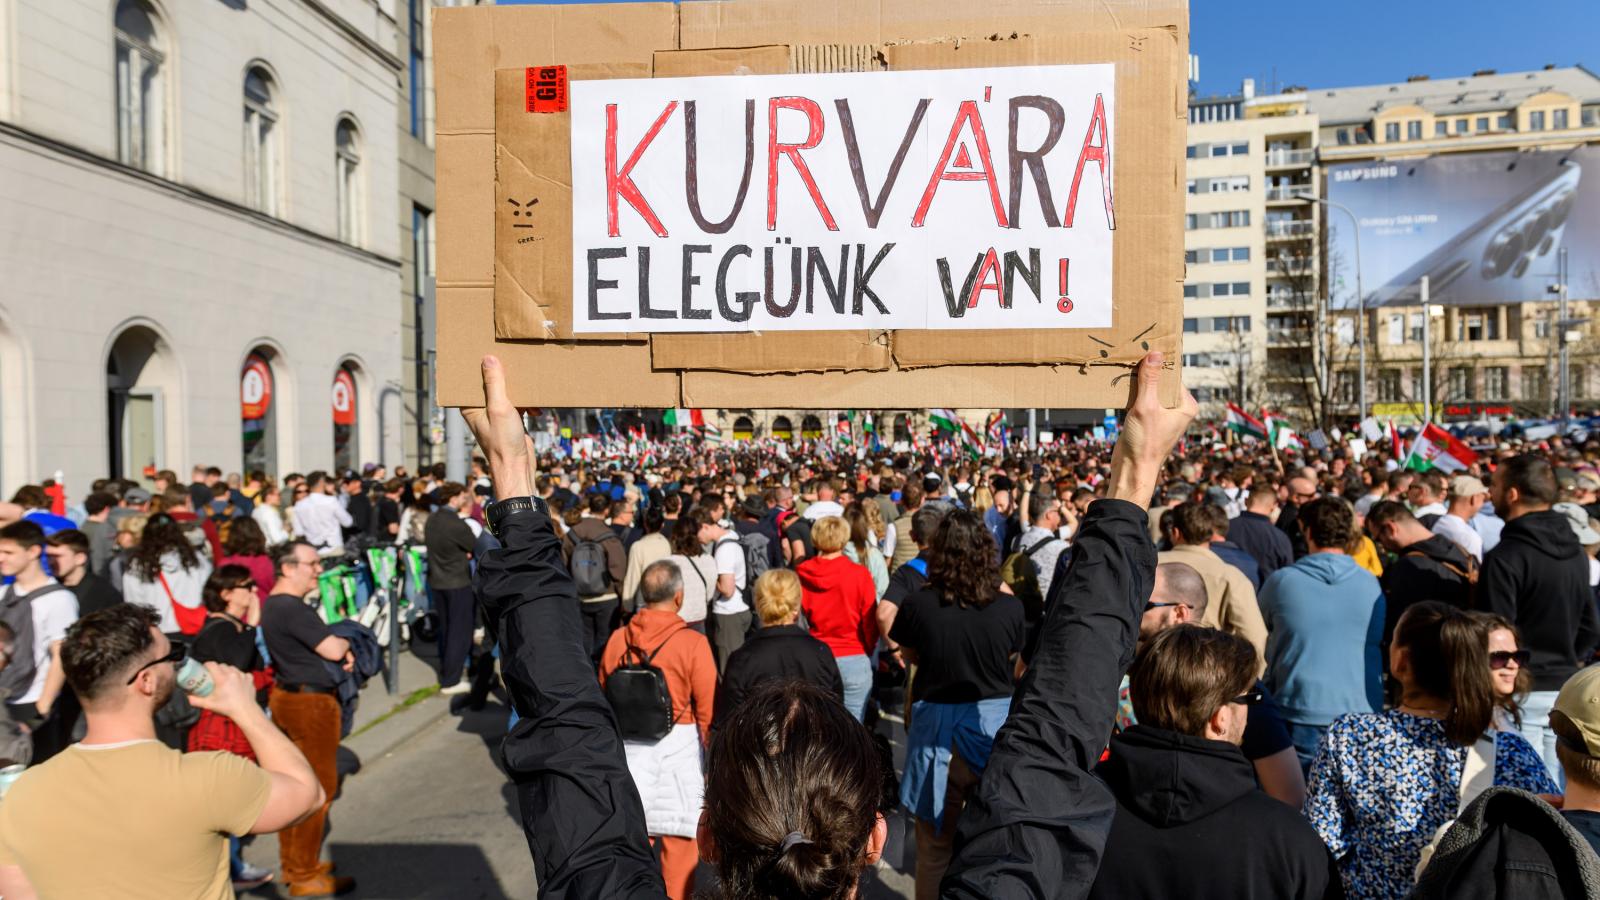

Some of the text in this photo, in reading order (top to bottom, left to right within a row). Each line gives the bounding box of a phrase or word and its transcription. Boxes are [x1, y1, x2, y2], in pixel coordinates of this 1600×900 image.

[605, 86, 1117, 238] KURVÁRA
[1334, 165, 1398, 182] SAMSUNG
[587, 237, 896, 322] ELEGÜNK
